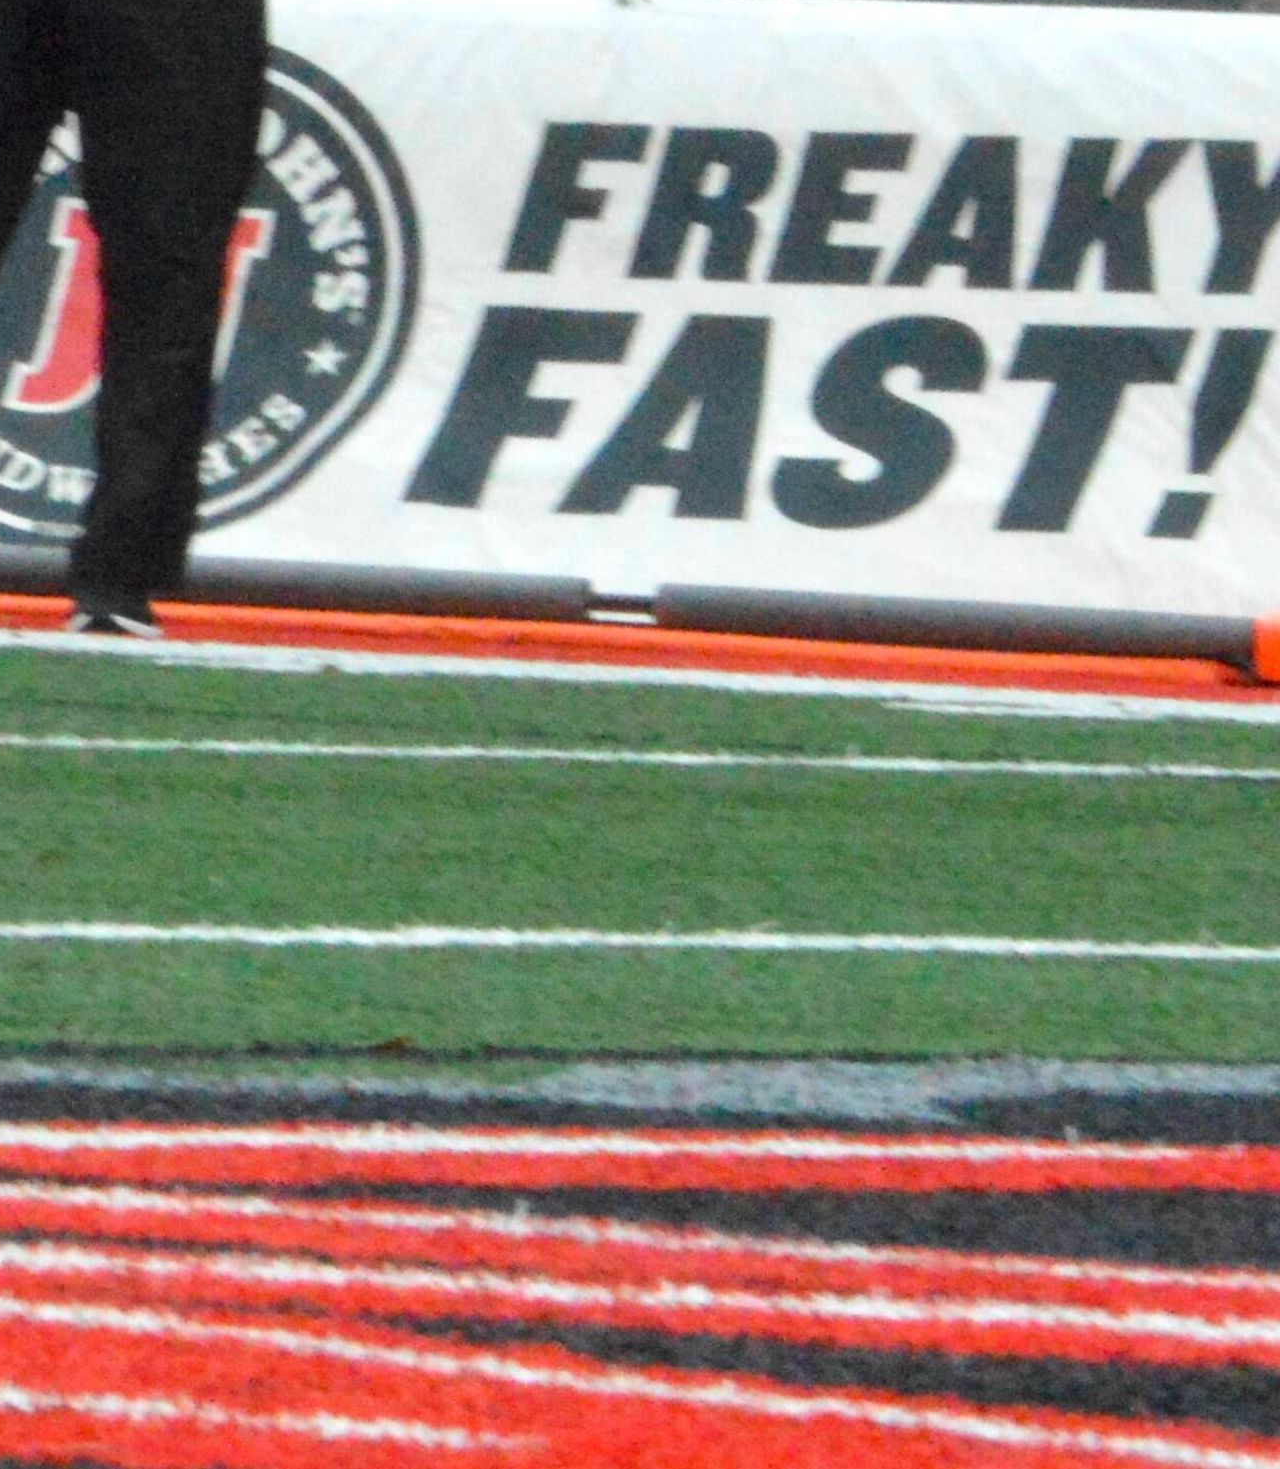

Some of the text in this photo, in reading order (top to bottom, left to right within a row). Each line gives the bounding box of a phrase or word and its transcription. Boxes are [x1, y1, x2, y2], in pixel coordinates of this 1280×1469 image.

[256, 107, 371, 314] HN'S
[502, 120, 1280, 295] FREAKY
[403, 304, 1274, 540] FAST!
